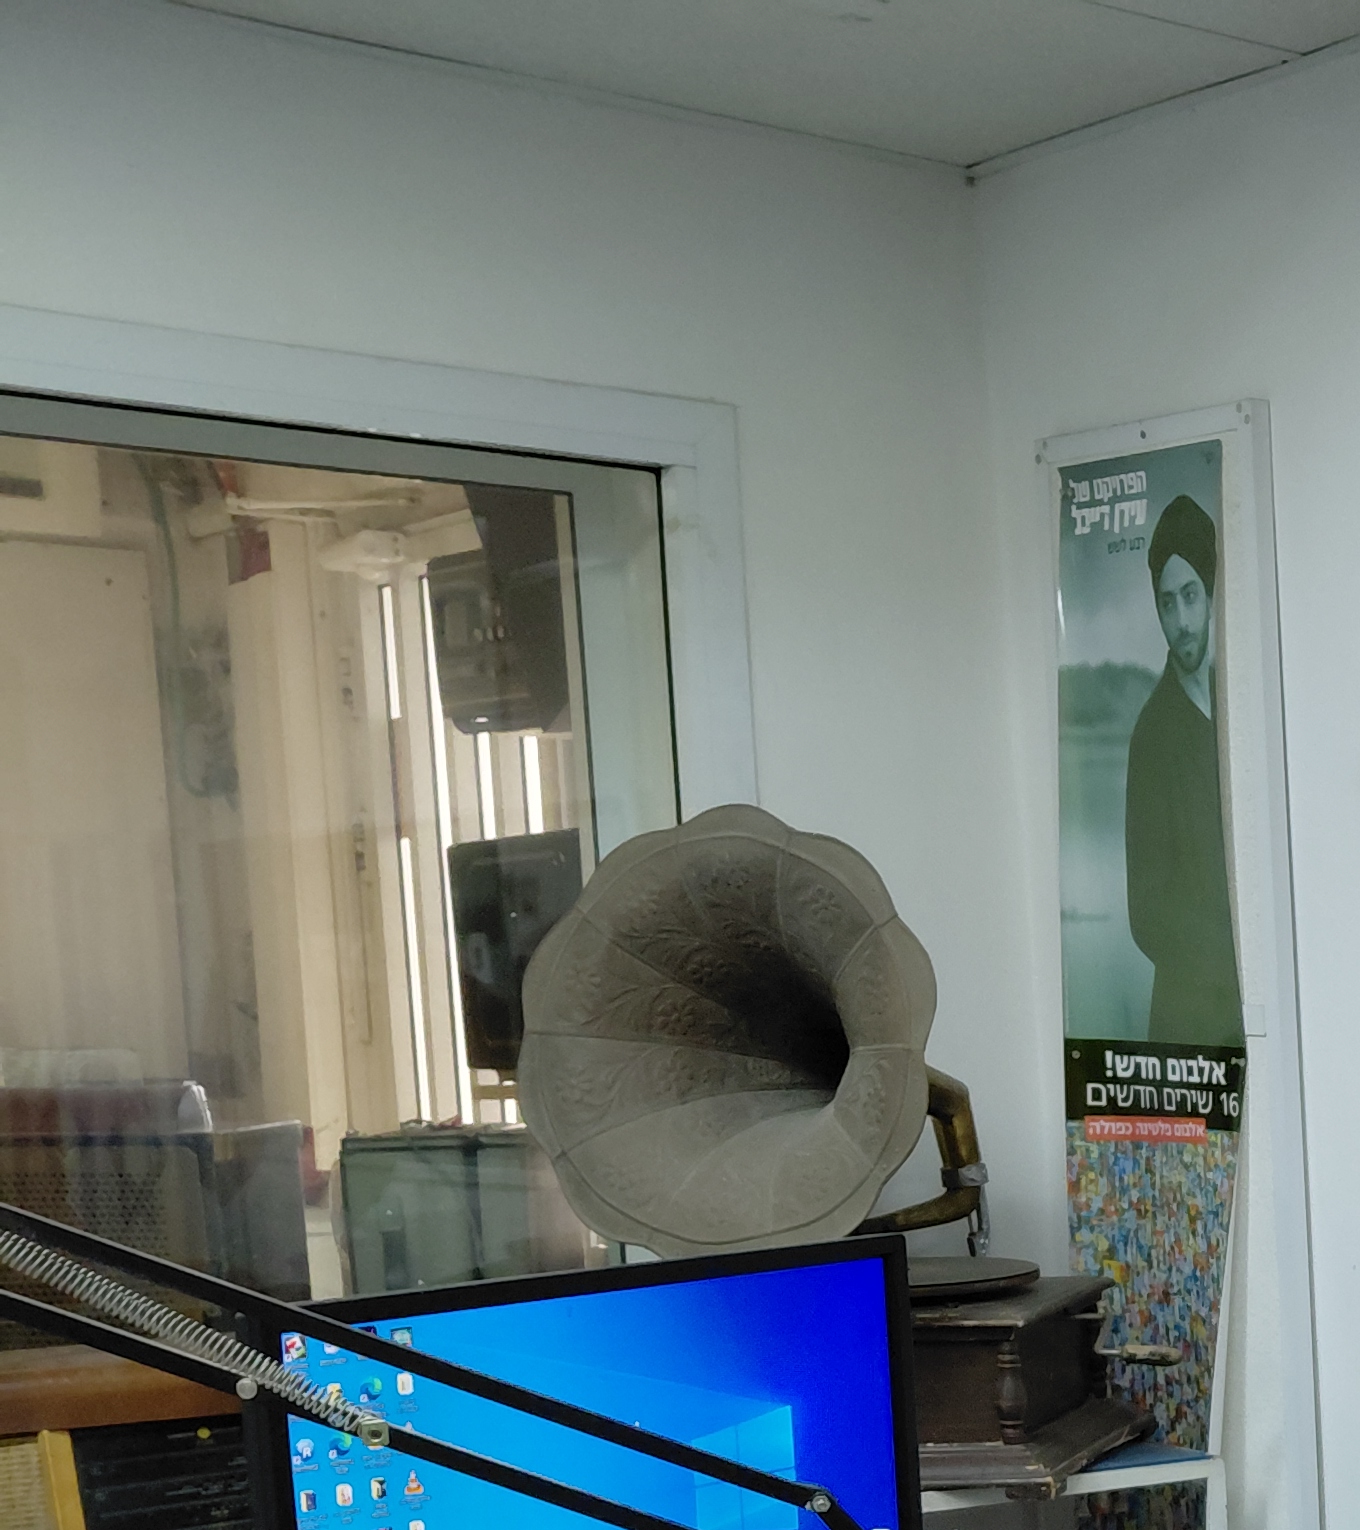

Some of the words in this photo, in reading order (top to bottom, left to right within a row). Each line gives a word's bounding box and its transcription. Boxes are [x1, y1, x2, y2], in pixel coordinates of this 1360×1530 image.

[1068, 479, 1090, 503] של
[1071, 504, 1110, 536] רייכל
[1114, 499, 1148, 534] עידן
[1104, 1050, 1161, 1081] חדש!
[1166, 1054, 1227, 1085] אלבום
[1086, 1082, 1158, 1110] חדשים
[1163, 1087, 1213, 1114] שירים
[1219, 1092, 1239, 1117] 16
[1088, 1119, 1133, 1136] כפולה
[1173, 1121, 1205, 1138] אלבום
